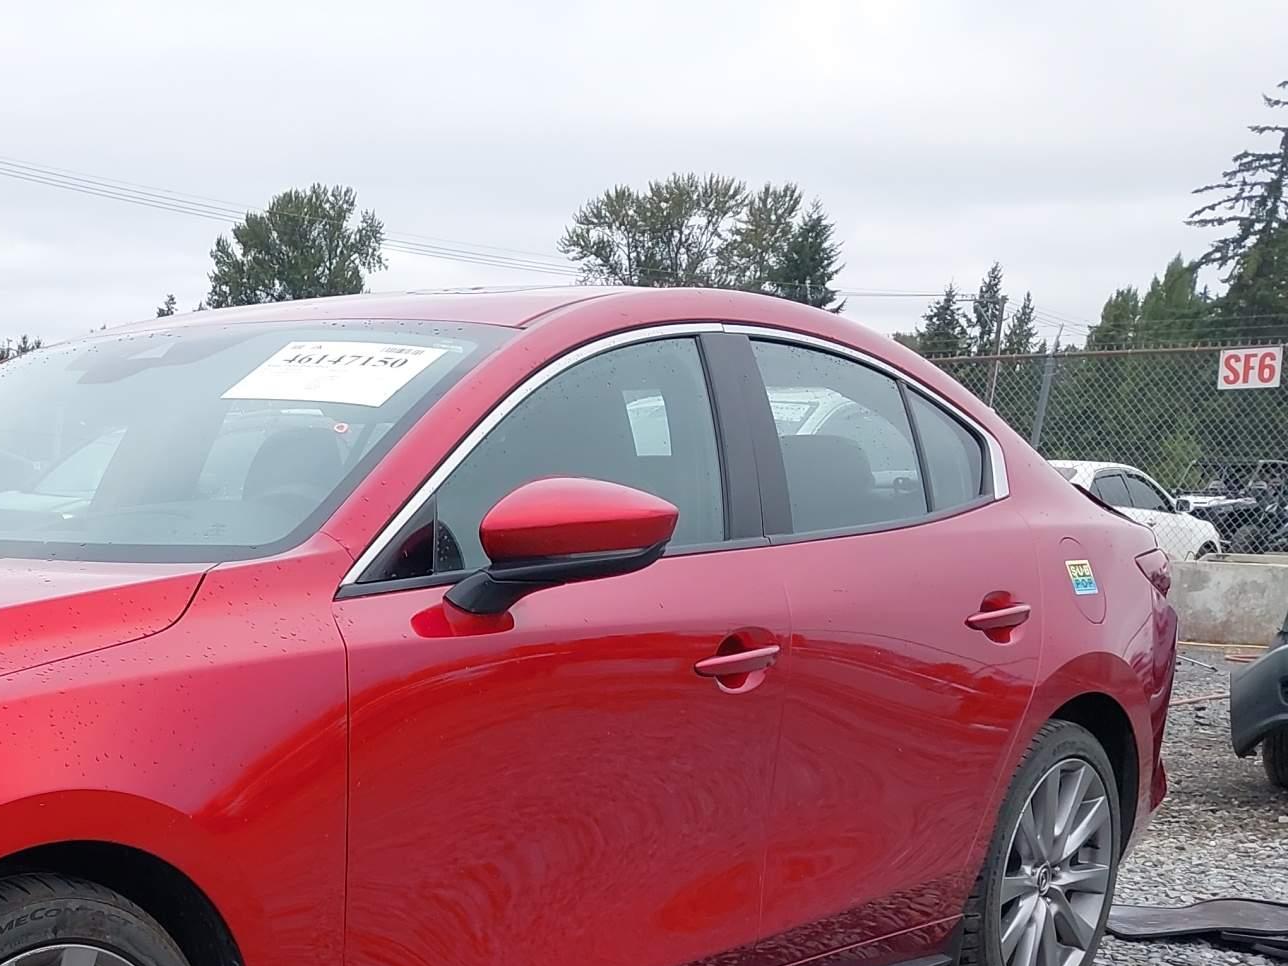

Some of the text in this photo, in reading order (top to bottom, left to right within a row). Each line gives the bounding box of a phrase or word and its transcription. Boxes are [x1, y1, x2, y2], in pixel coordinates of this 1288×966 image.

[283, 353, 409, 368] 46147150
[1223, 351, 1277, 385] SF6
[1069, 564, 1091, 577] SUB
